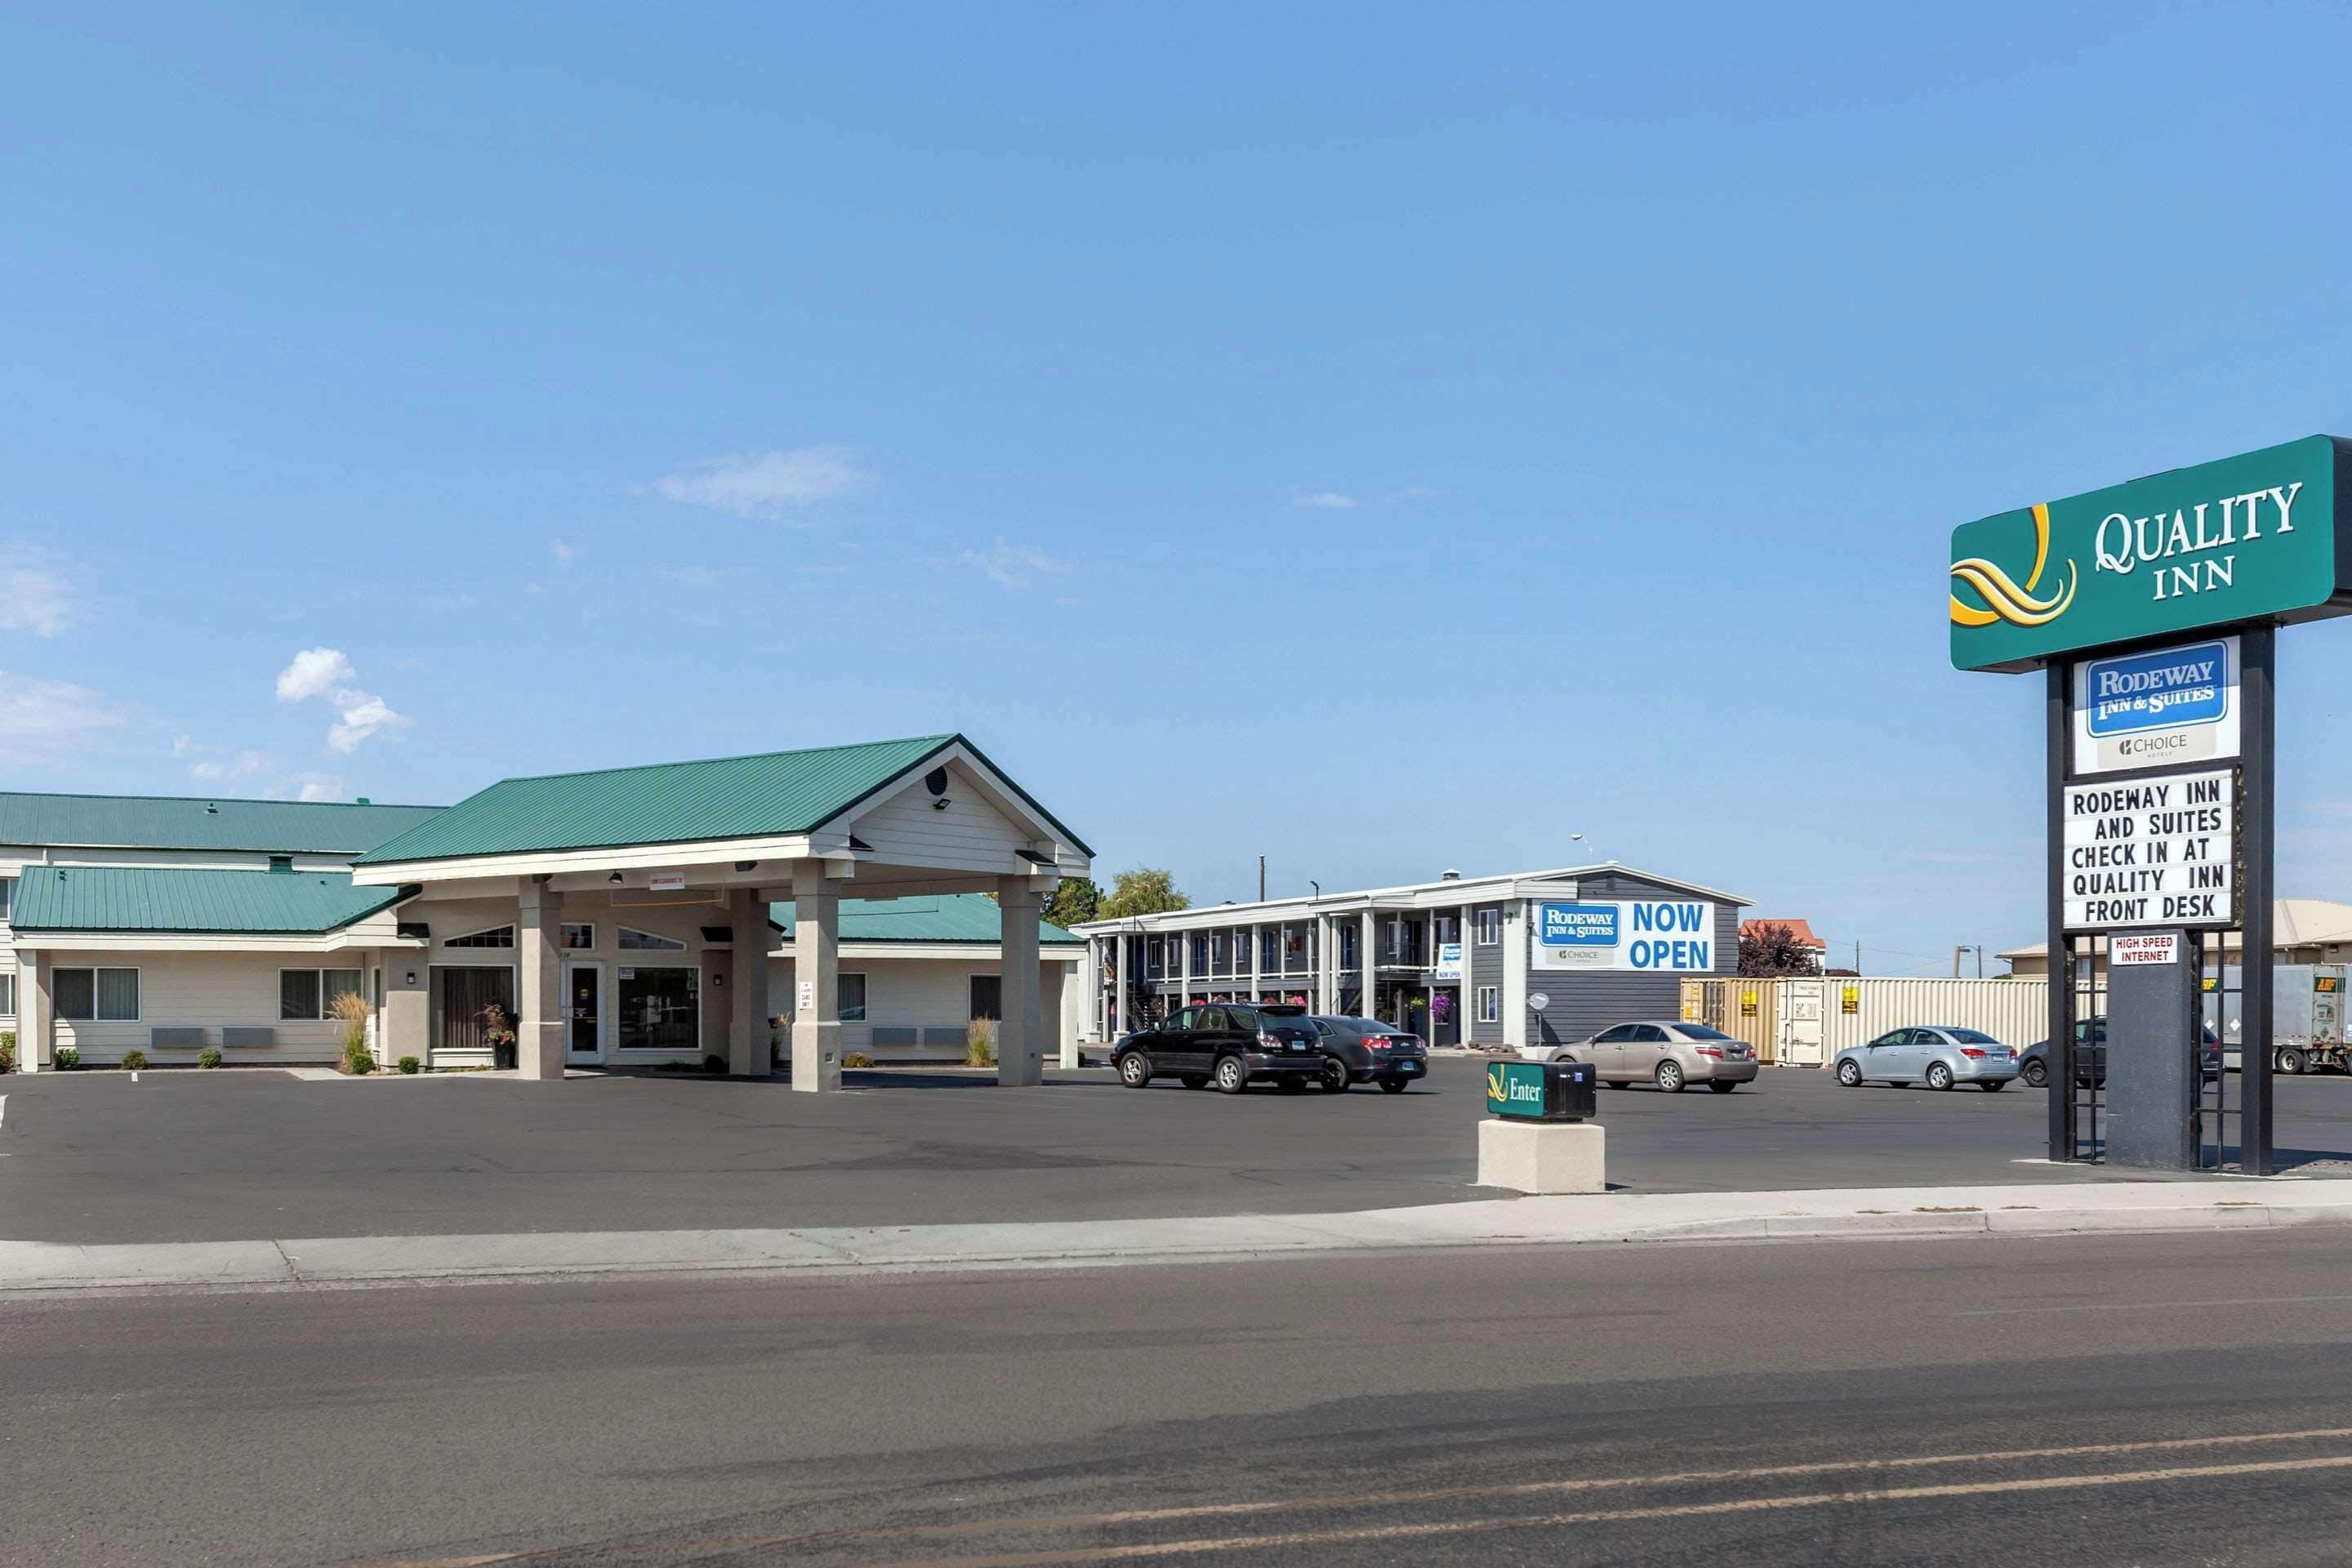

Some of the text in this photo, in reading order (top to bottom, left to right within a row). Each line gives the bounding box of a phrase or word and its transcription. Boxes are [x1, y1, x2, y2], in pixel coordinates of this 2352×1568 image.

[2095, 482, 2302, 574] QUALITY
[2152, 555, 2235, 601] INN
[2098, 661, 2215, 697] RODEWAY
[2098, 684, 2216, 720] INN & SUITES
[2133, 734, 2187, 752] CHOICE
[2074, 779, 2221, 815] RODEWAY INN
[2095, 807, 2221, 840] AND SUITES
[2072, 837, 2210, 869] CHECK IN AT
[2073, 865, 2224, 895] QUALITY INN
[1546, 909, 1614, 925] RODEWAY
[1633, 903, 1704, 932] NOW
[2085, 894, 2215, 922] FRONT DESK
[1546, 925, 1615, 938] INN & SUITES
[2116, 937, 2172, 949] HIGH SPEED
[1568, 951, 1599, 959] CHOICE
[1629, 939, 1708, 969] OPEN
[2122, 950, 2169, 961] INTERNET
[1509, 1077, 1542, 1102] Enter
